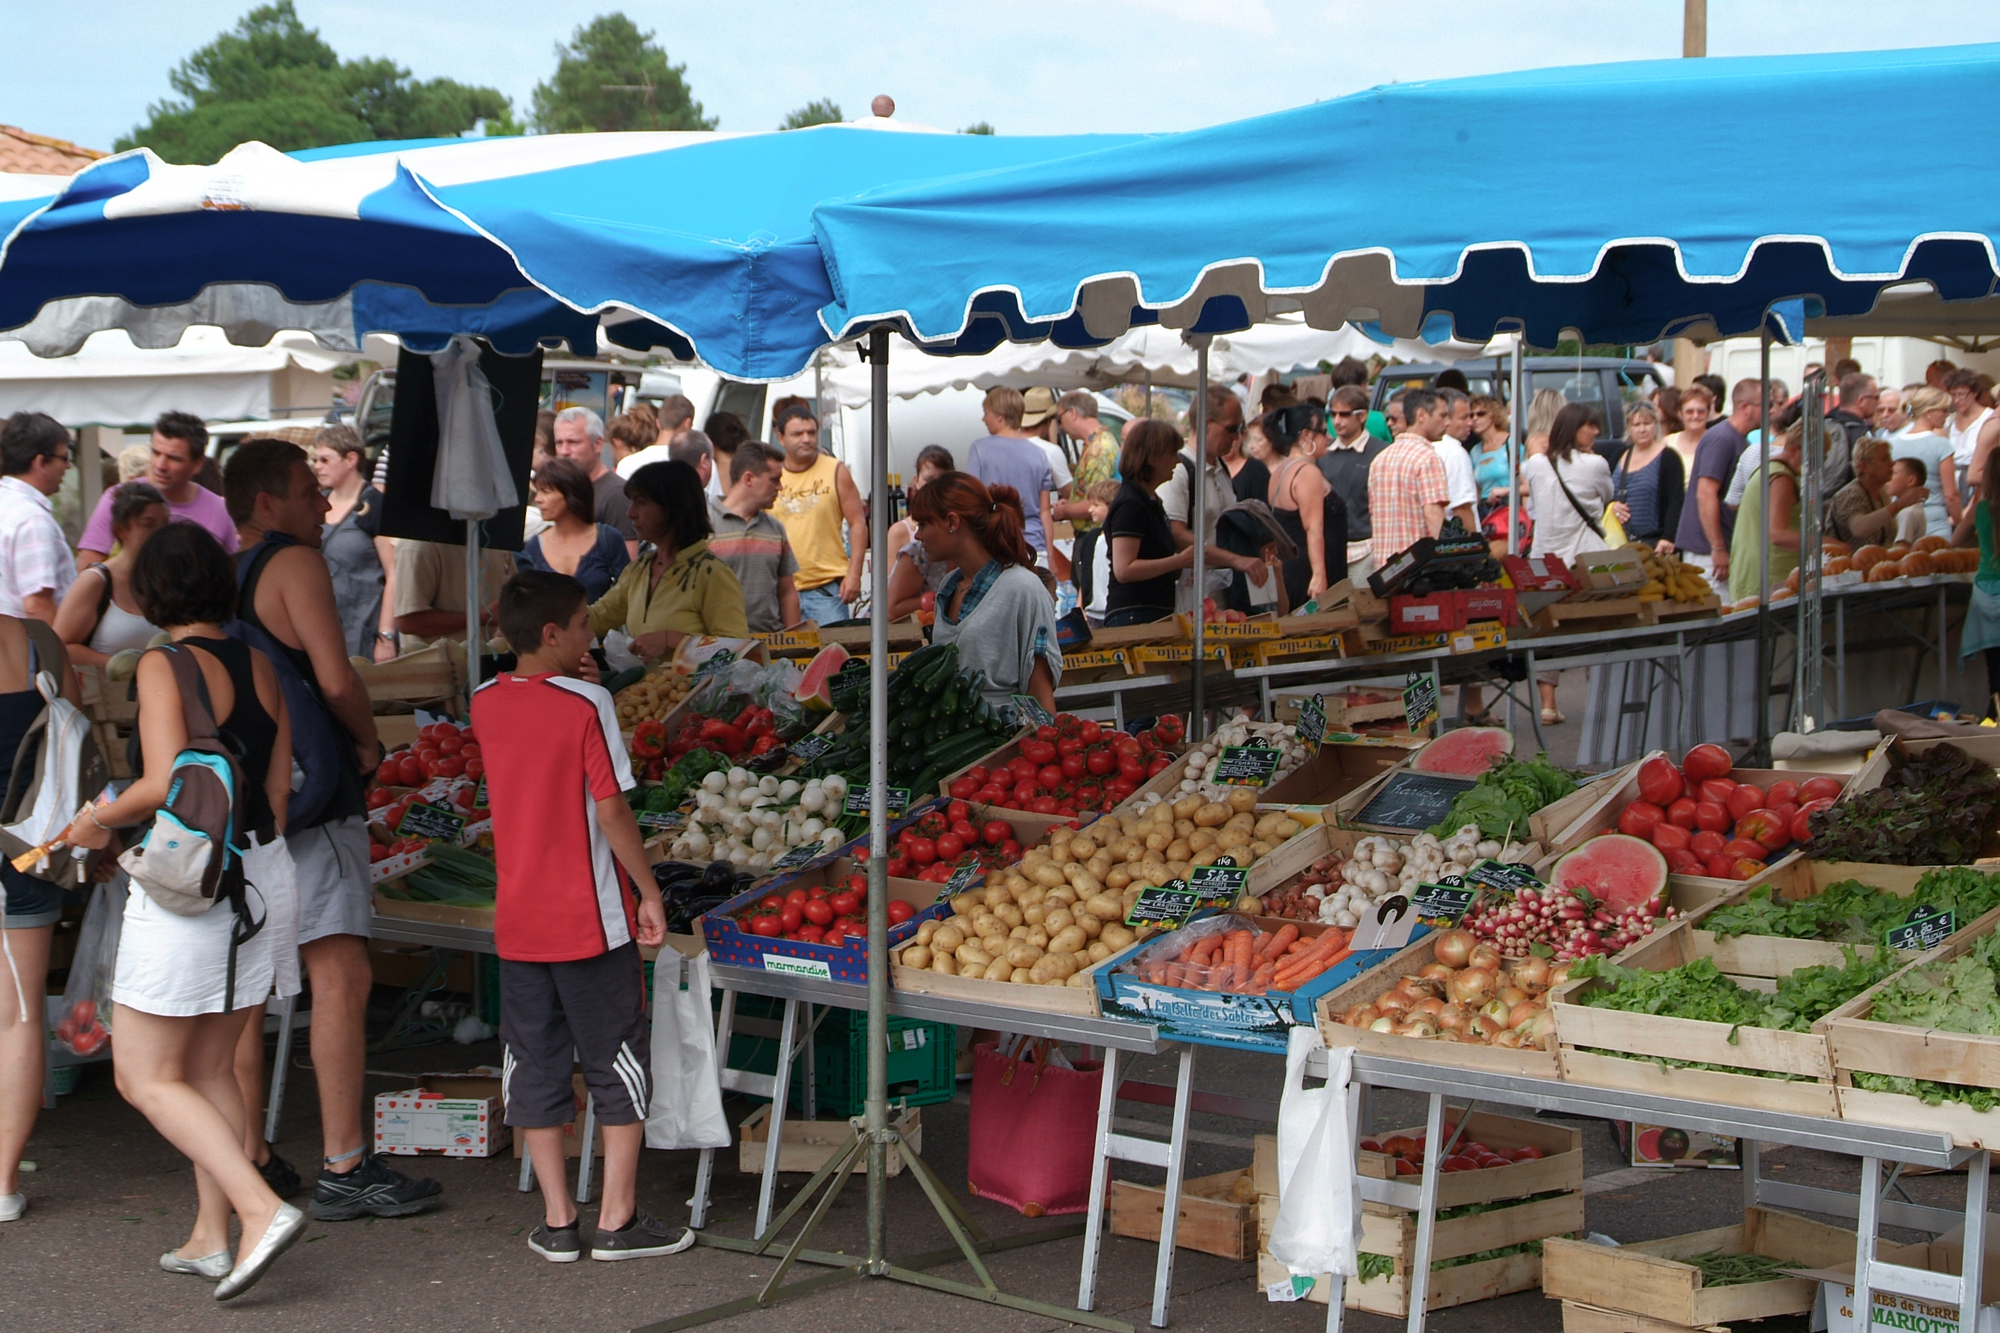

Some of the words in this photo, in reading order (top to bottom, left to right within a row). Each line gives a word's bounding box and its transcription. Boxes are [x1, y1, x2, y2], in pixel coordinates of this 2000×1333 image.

[1213, 623, 1261, 635] Utrilla
[751, 633, 796, 649] trilla
[1217, 857, 1231, 866] 1Kg
[1234, 871, 1242, 880] €
[1445, 876, 1461, 886] 1Kg
[1171, 879, 1185, 891] 1Kg
[1184, 895, 1193, 903] €
[1460, 892, 1469, 901] €
[1939, 915, 1948, 925] €
[766, 961, 829, 977] marmandise
[1154, 999, 1169, 1014] La
[1171, 1001, 1198, 1018] Belle
[1202, 1004, 1220, 1020] des
[1222, 1007, 1257, 1024] Sables
[1839, 1305, 1853, 1319] de
[1900, 1300, 1915, 1312] de
[1917, 1304, 1959, 1322] TERRE
